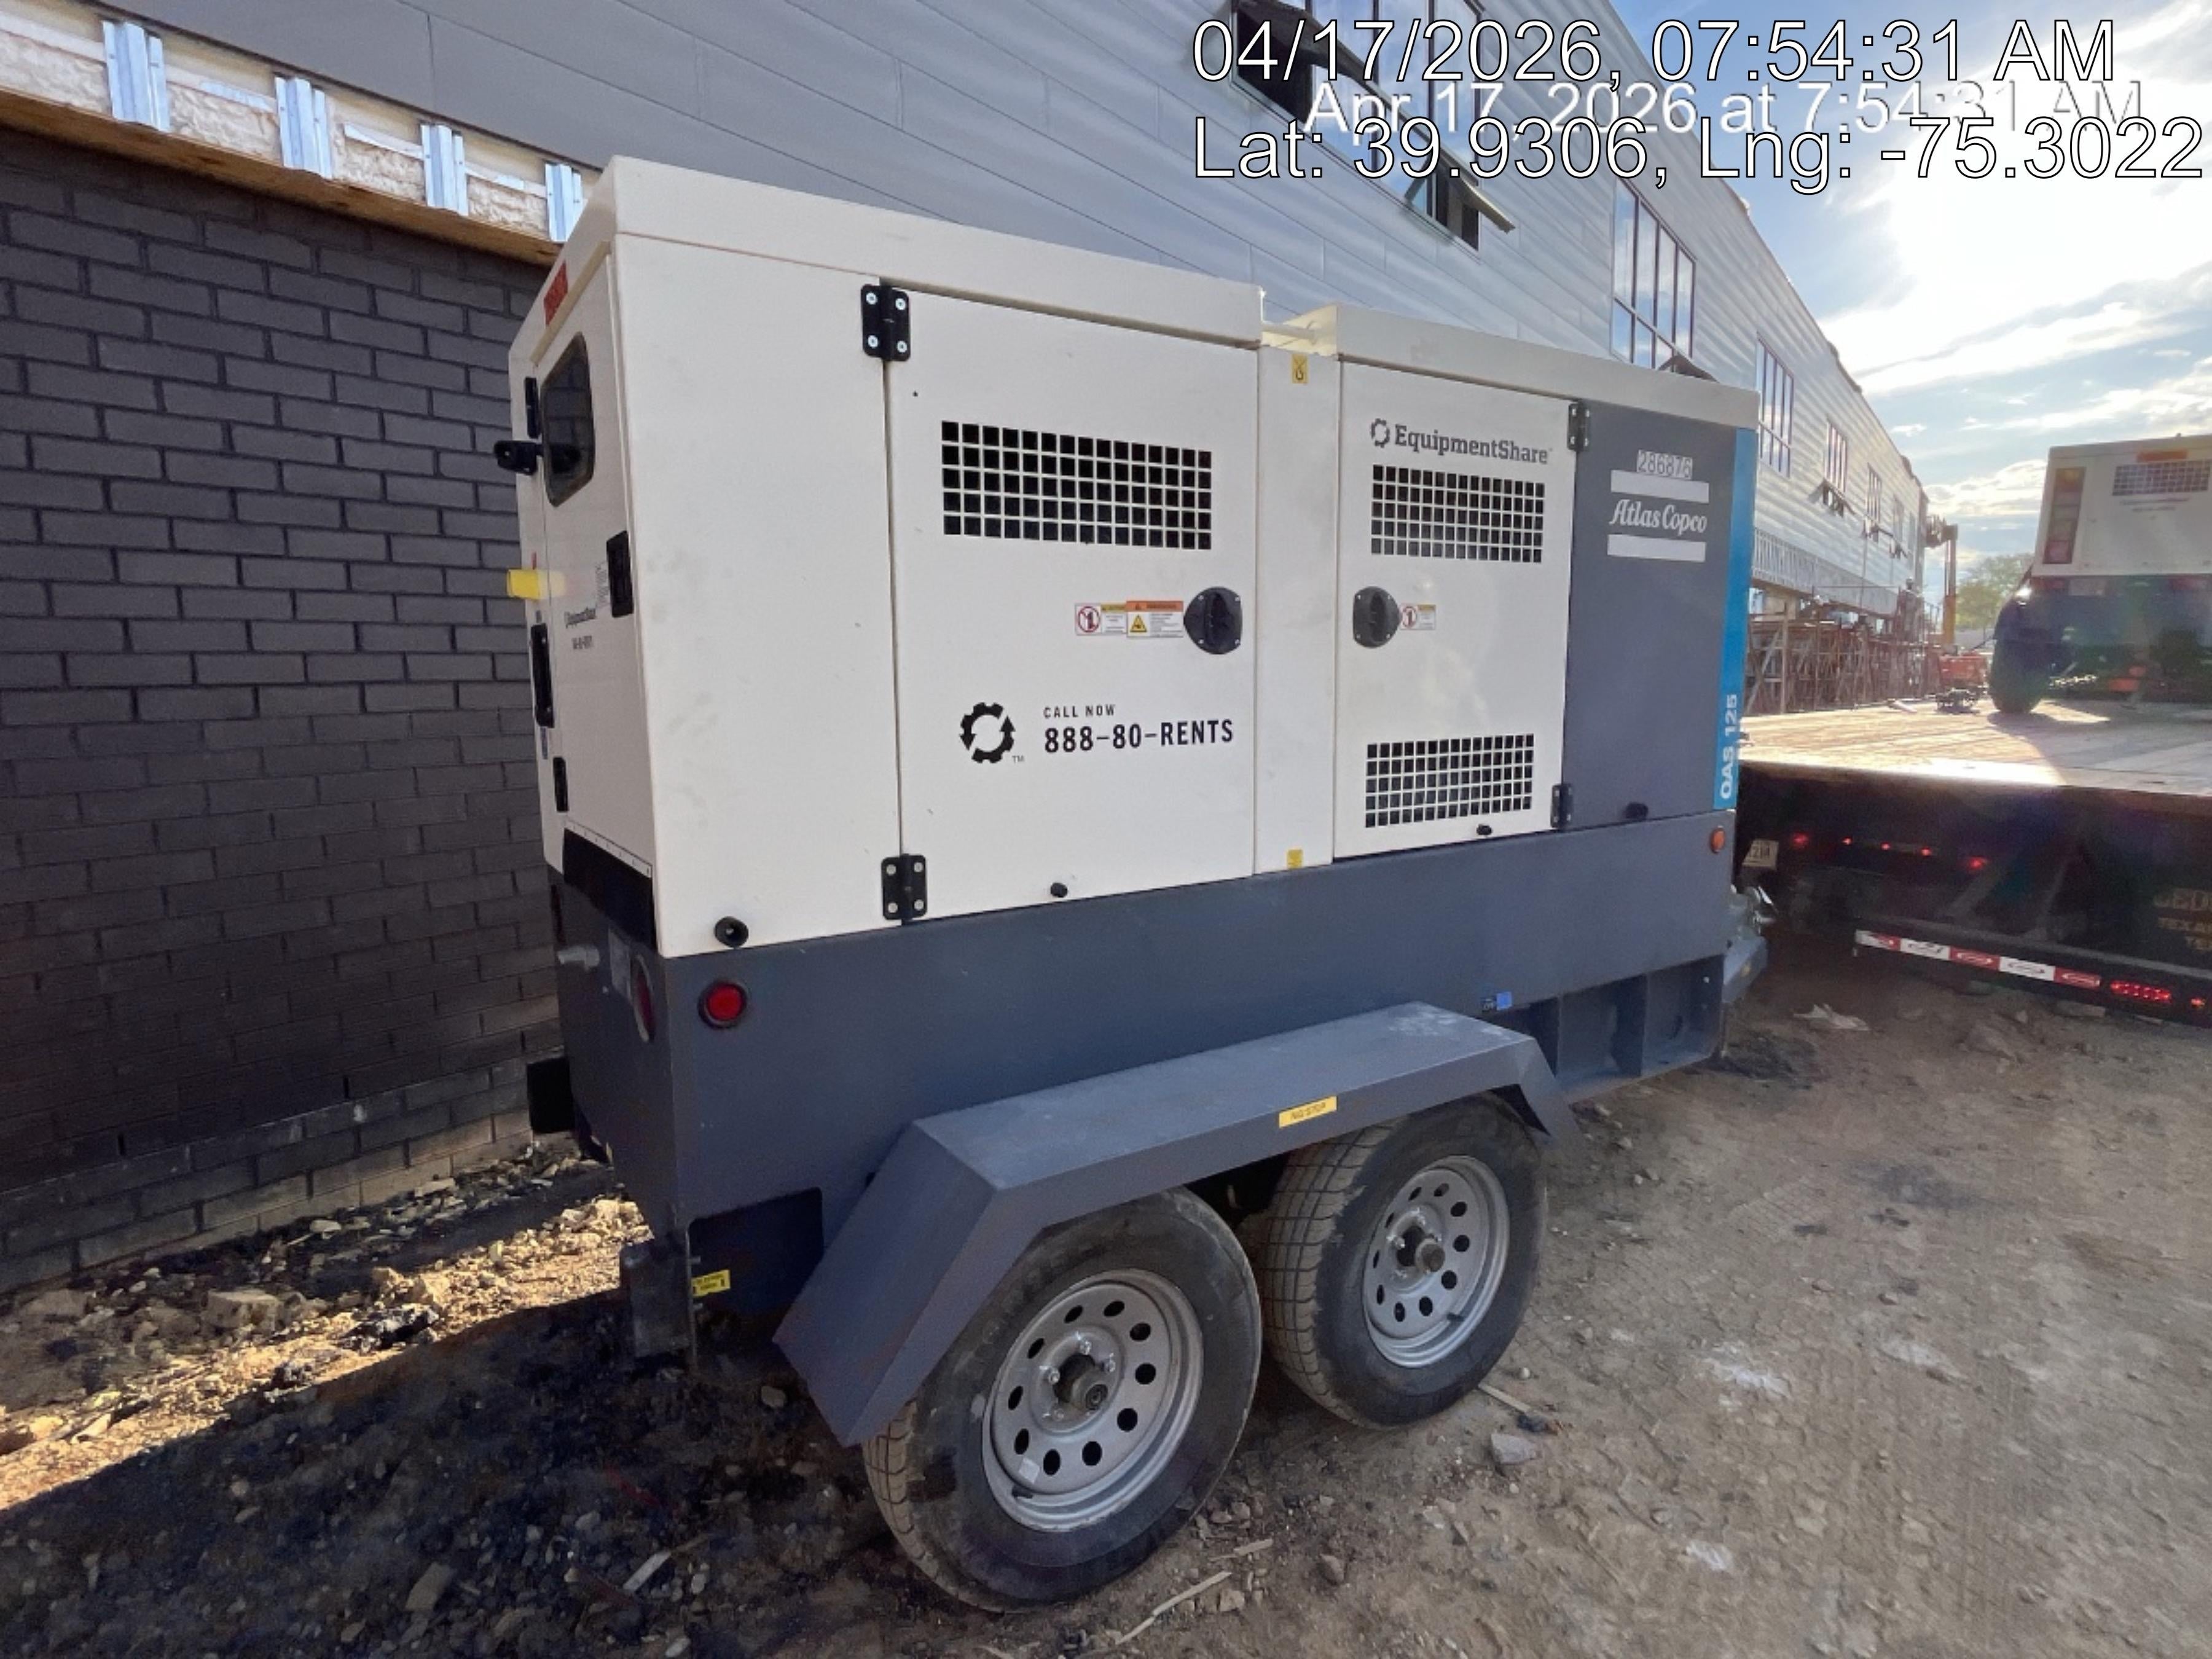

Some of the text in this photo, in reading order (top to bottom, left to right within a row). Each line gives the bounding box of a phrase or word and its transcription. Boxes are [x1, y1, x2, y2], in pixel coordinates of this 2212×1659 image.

[1395, 423, 1548, 464] EquipmentShare
[1609, 499, 1708, 536] Atlas Copco
[1044, 704, 1115, 718] CALL NOW
[1045, 719, 1233, 753] 888-80-RENTS
